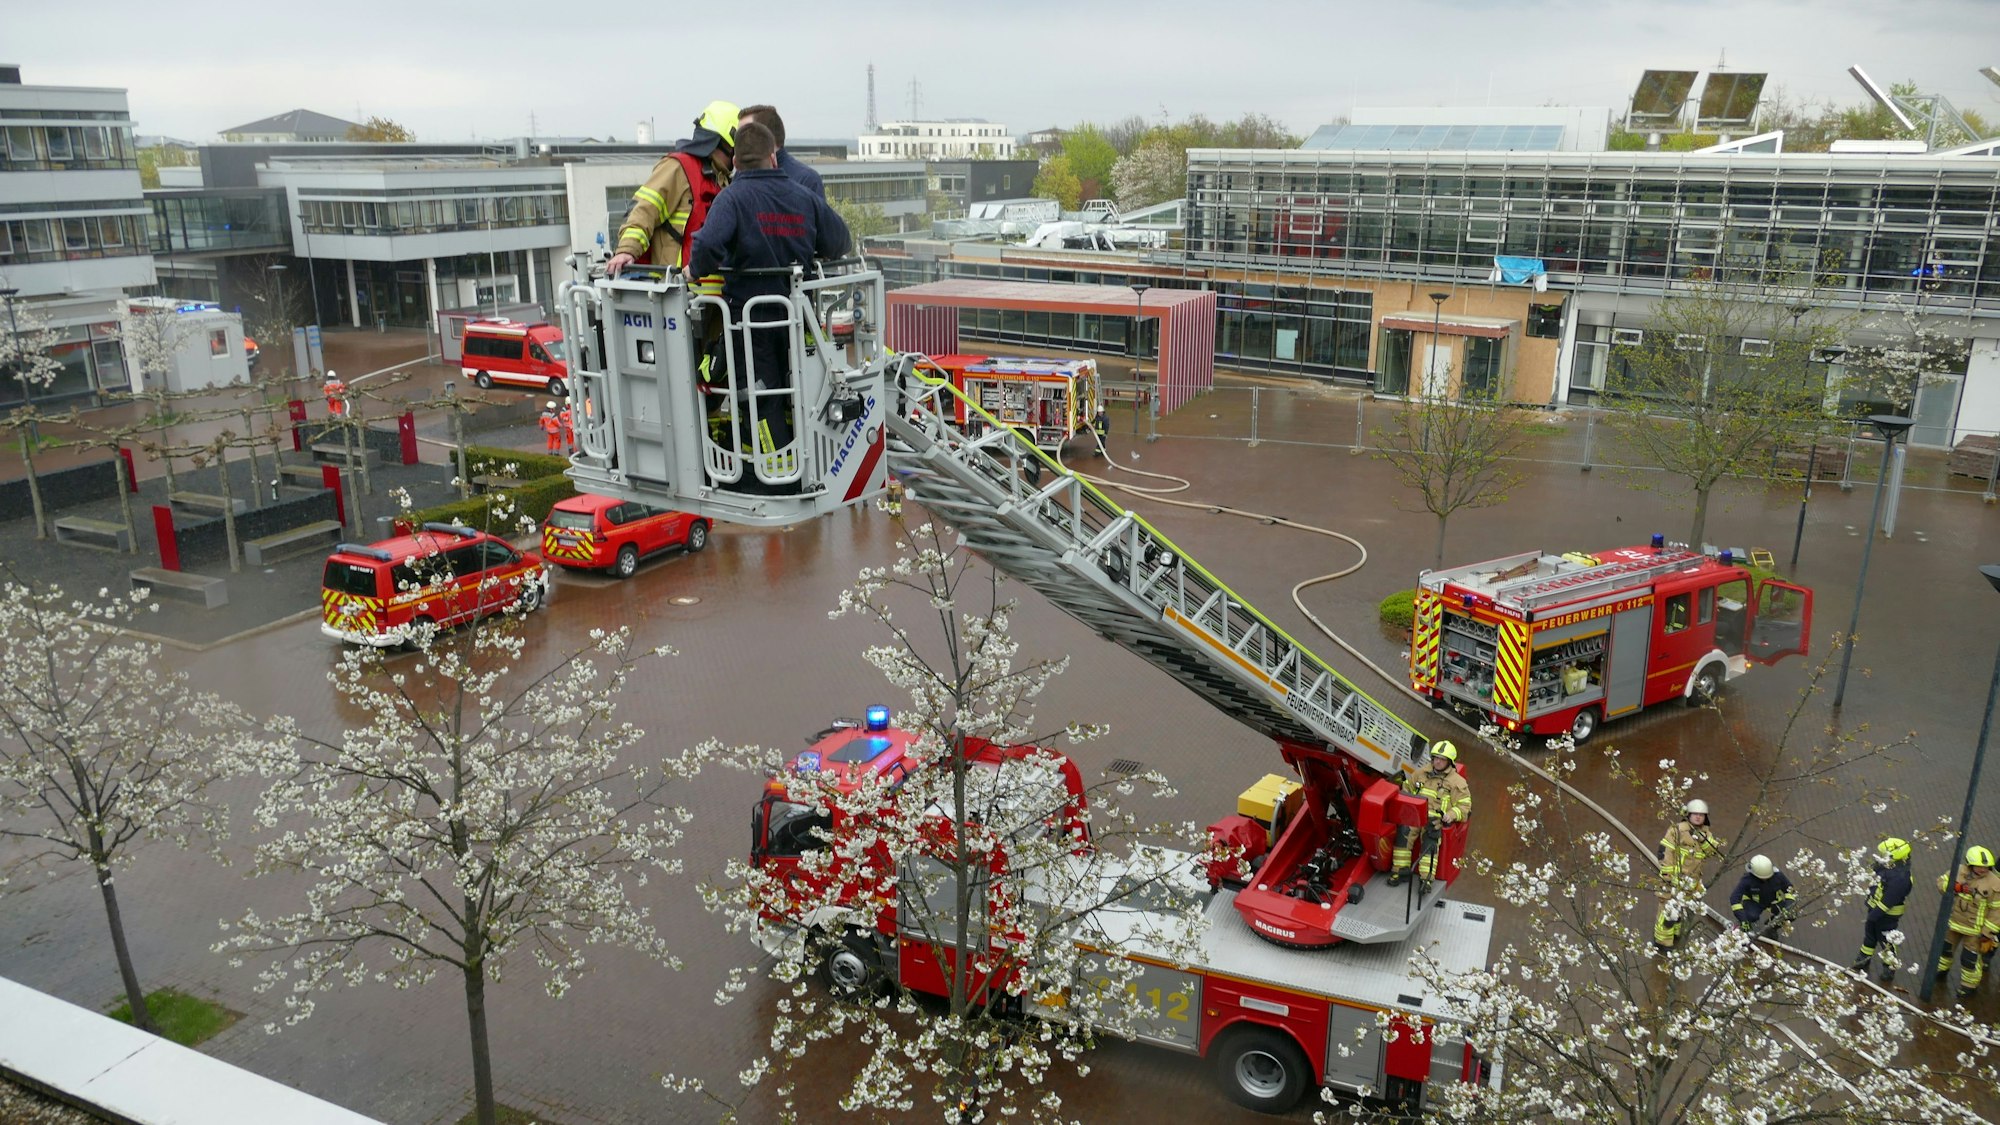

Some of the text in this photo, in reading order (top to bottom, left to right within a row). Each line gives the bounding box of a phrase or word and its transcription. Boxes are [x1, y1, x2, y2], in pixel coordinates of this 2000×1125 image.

[830, 395, 876, 477] MAGIRUS
[1541, 598, 1644, 630] FEUERWEHR 112
[1286, 691, 1356, 745] FEUERWEHR RHEINBACH
[1255, 919, 1295, 939] MAGIRUS
